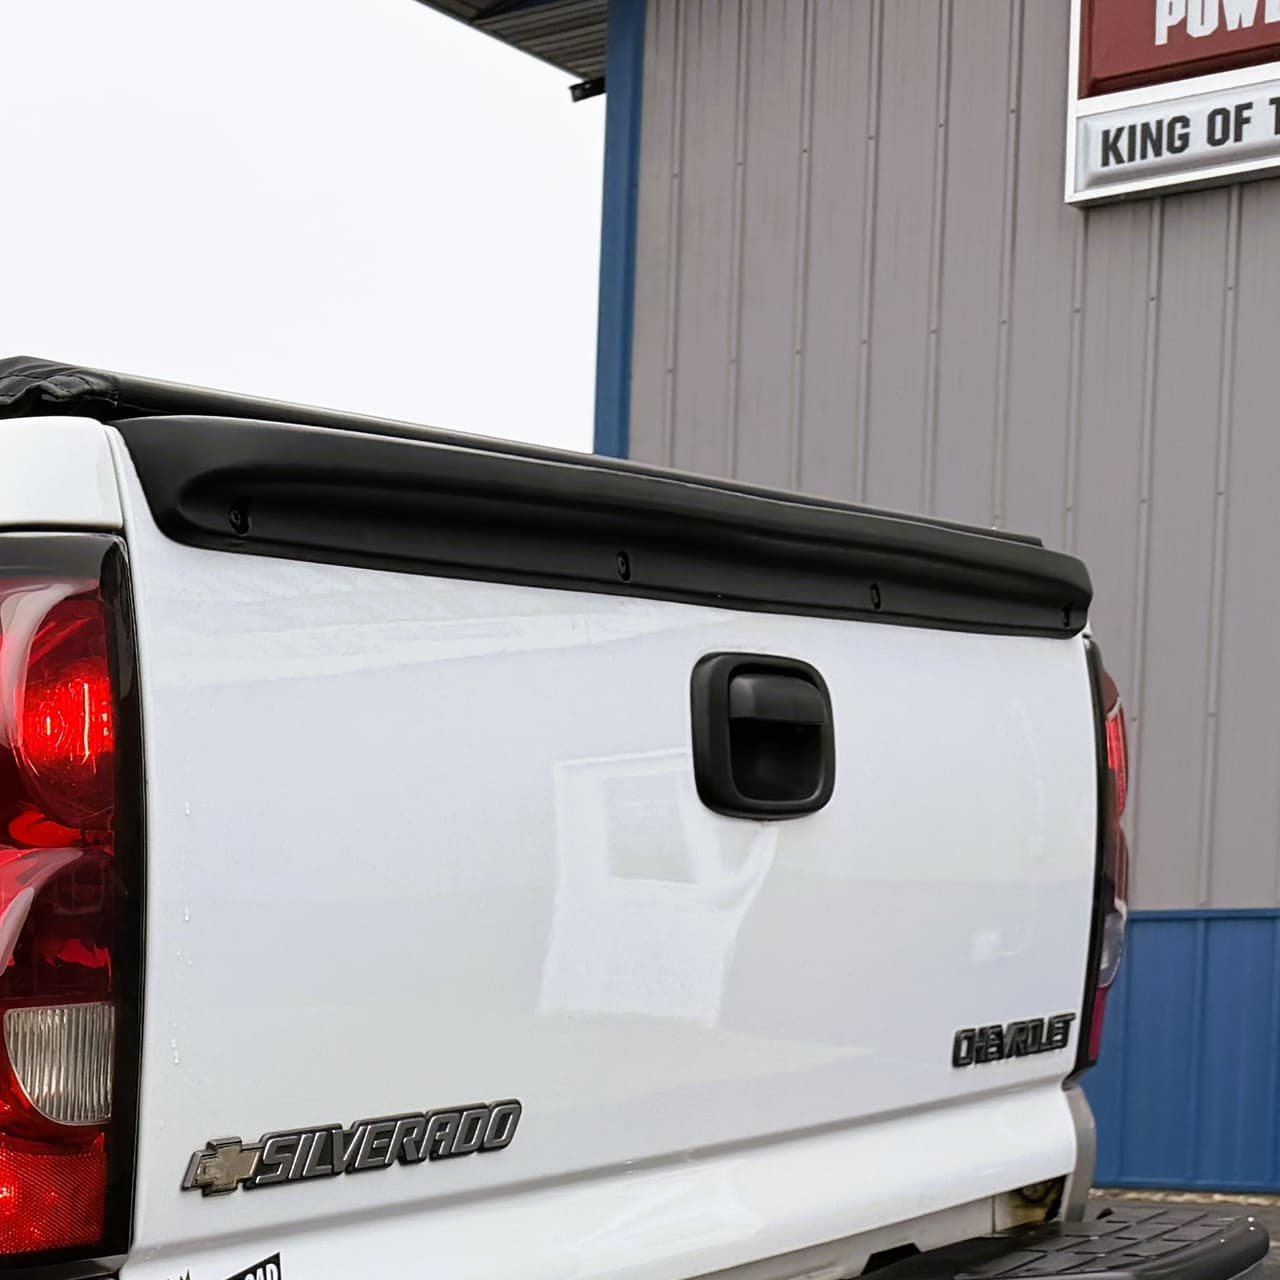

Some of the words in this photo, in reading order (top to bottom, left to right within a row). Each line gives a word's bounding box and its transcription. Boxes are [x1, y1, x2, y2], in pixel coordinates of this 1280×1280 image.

[1101, 114, 1190, 167] KING
[1207, 102, 1253, 147] OF
[951, 1012, 1076, 1067] CHEVROLET
[252, 1100, 522, 1188] SILVERADO
